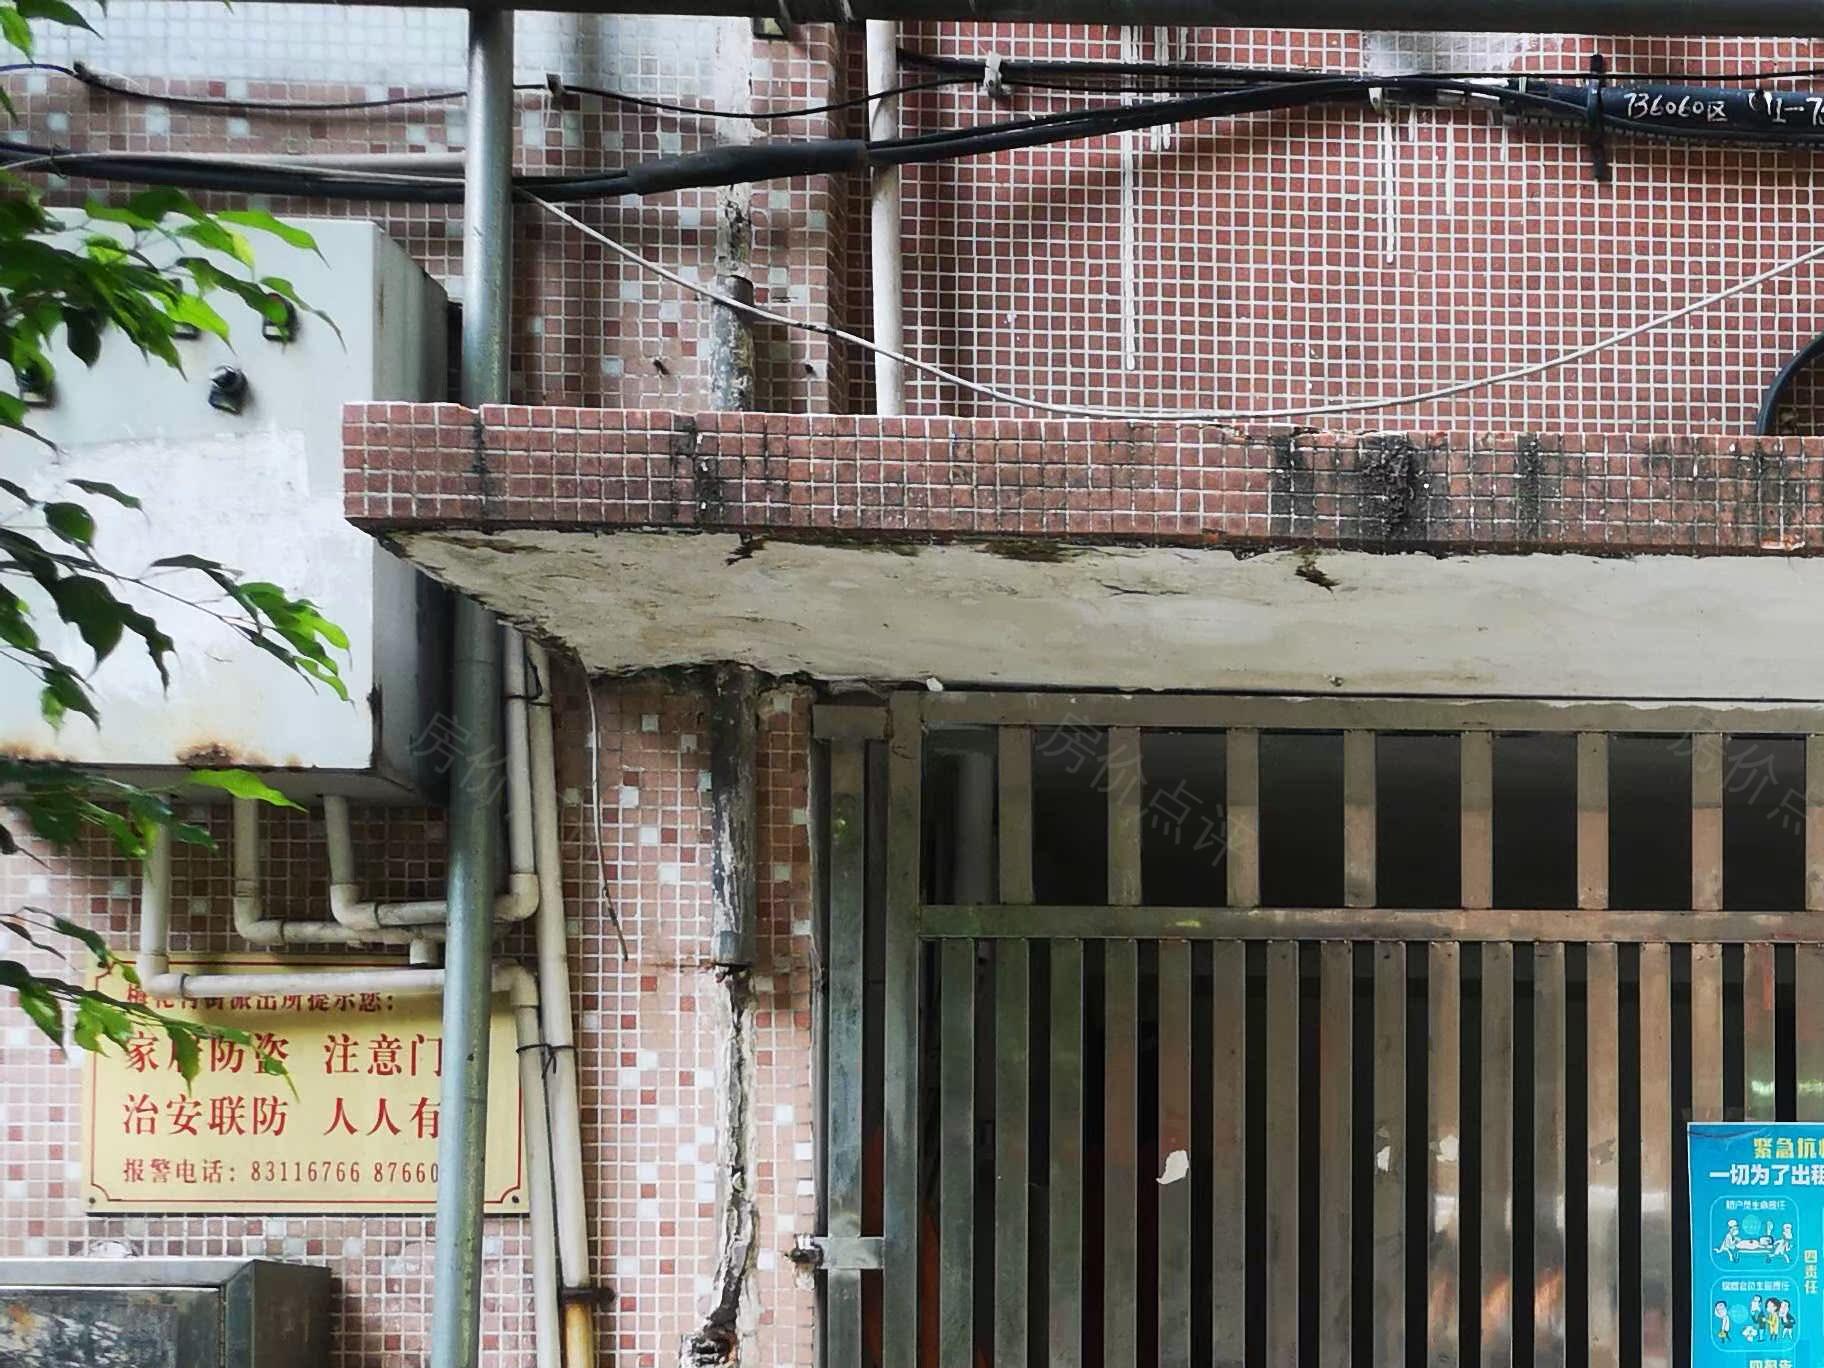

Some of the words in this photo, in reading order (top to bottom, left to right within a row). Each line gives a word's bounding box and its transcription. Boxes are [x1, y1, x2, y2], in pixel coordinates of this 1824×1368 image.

[127, 1031, 289, 1074] 家防盗
[122, 1094, 288, 1137] 治安联防
